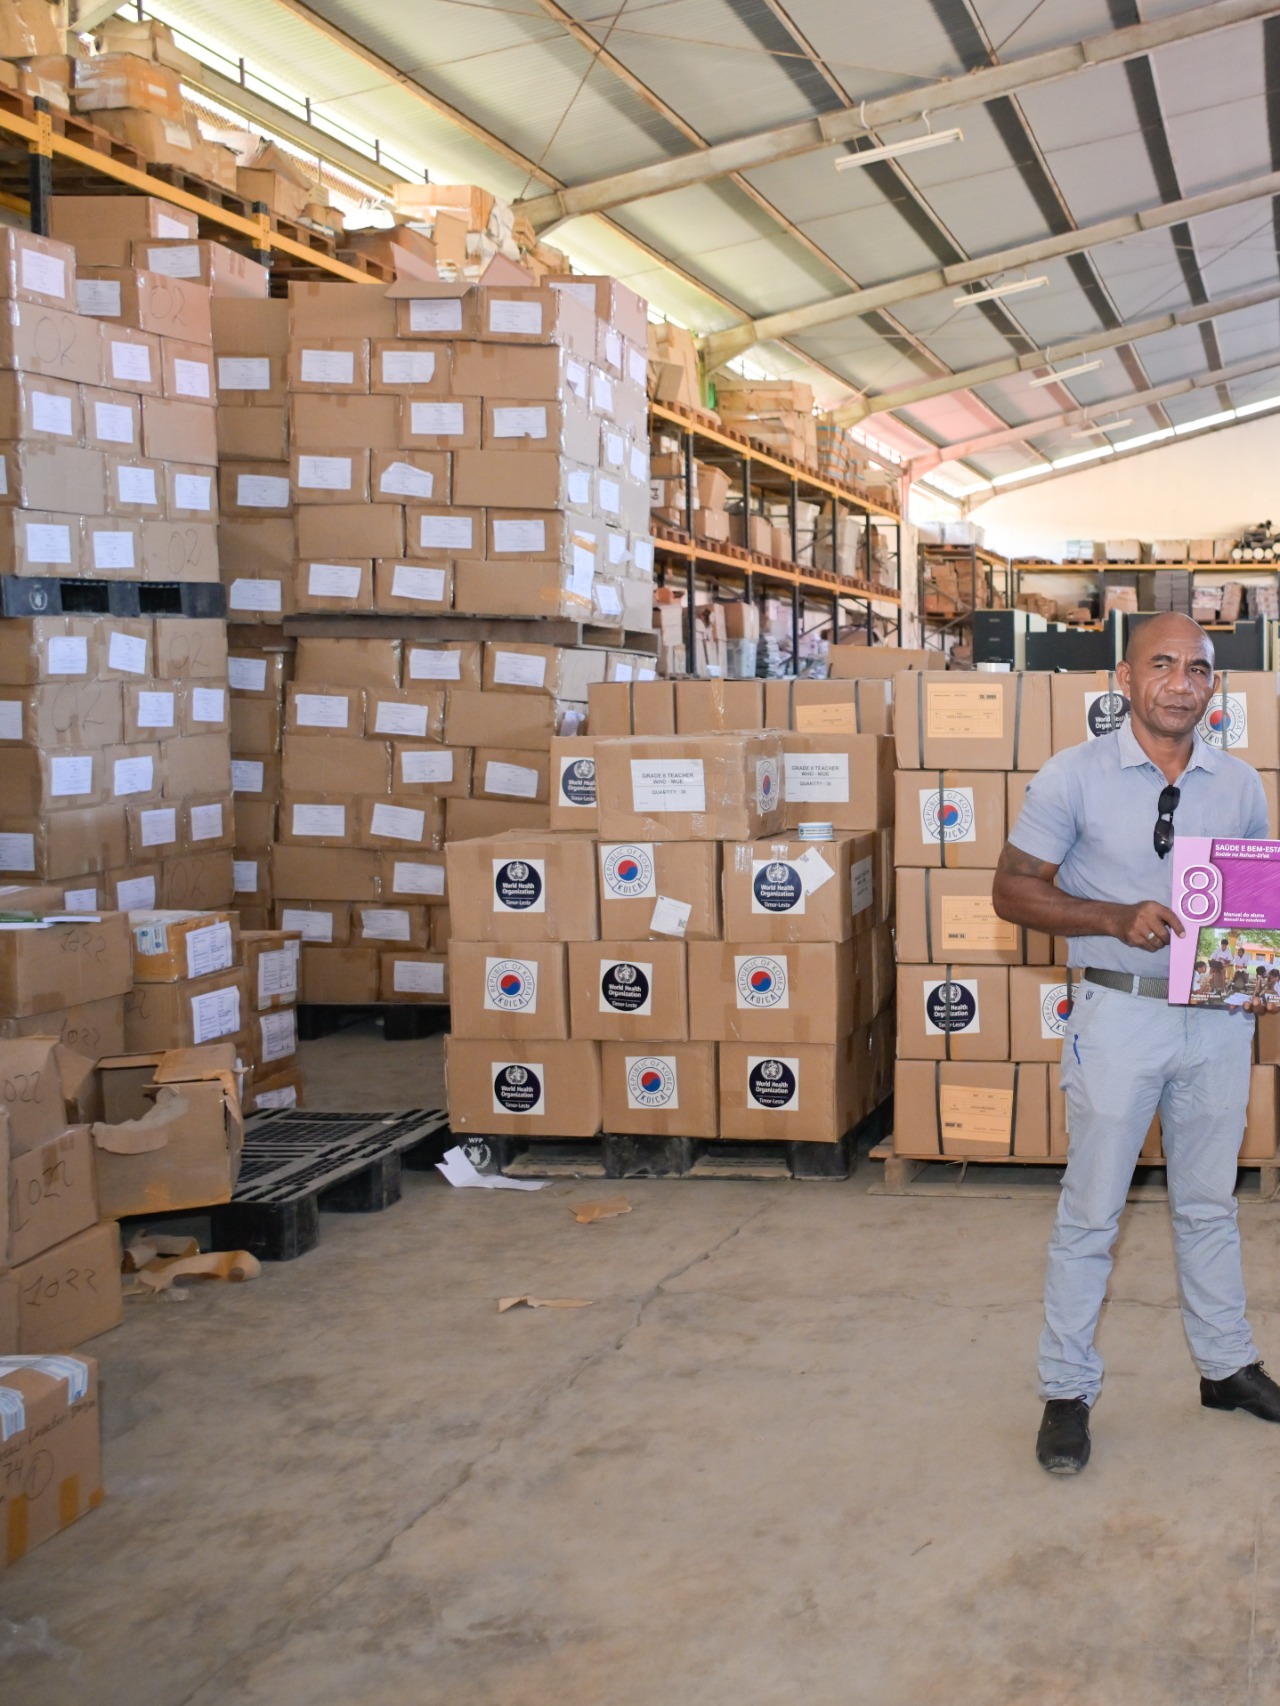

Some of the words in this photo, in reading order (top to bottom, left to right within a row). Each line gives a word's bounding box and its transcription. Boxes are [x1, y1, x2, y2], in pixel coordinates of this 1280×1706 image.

[151, 284, 187, 327] 02
[33, 316, 77, 366] 02
[168, 529, 199, 575] 02
[617, 883, 643, 893] KOICA
[1179, 864, 1219, 923] 8
[498, 997, 524, 1007] KOICA
[608, 990, 641, 998] Organization
[750, 994, 776, 1004] KOICA
[641, 1094, 666, 1104] KOICA
[24, 1268, 98, 1306] 1022
